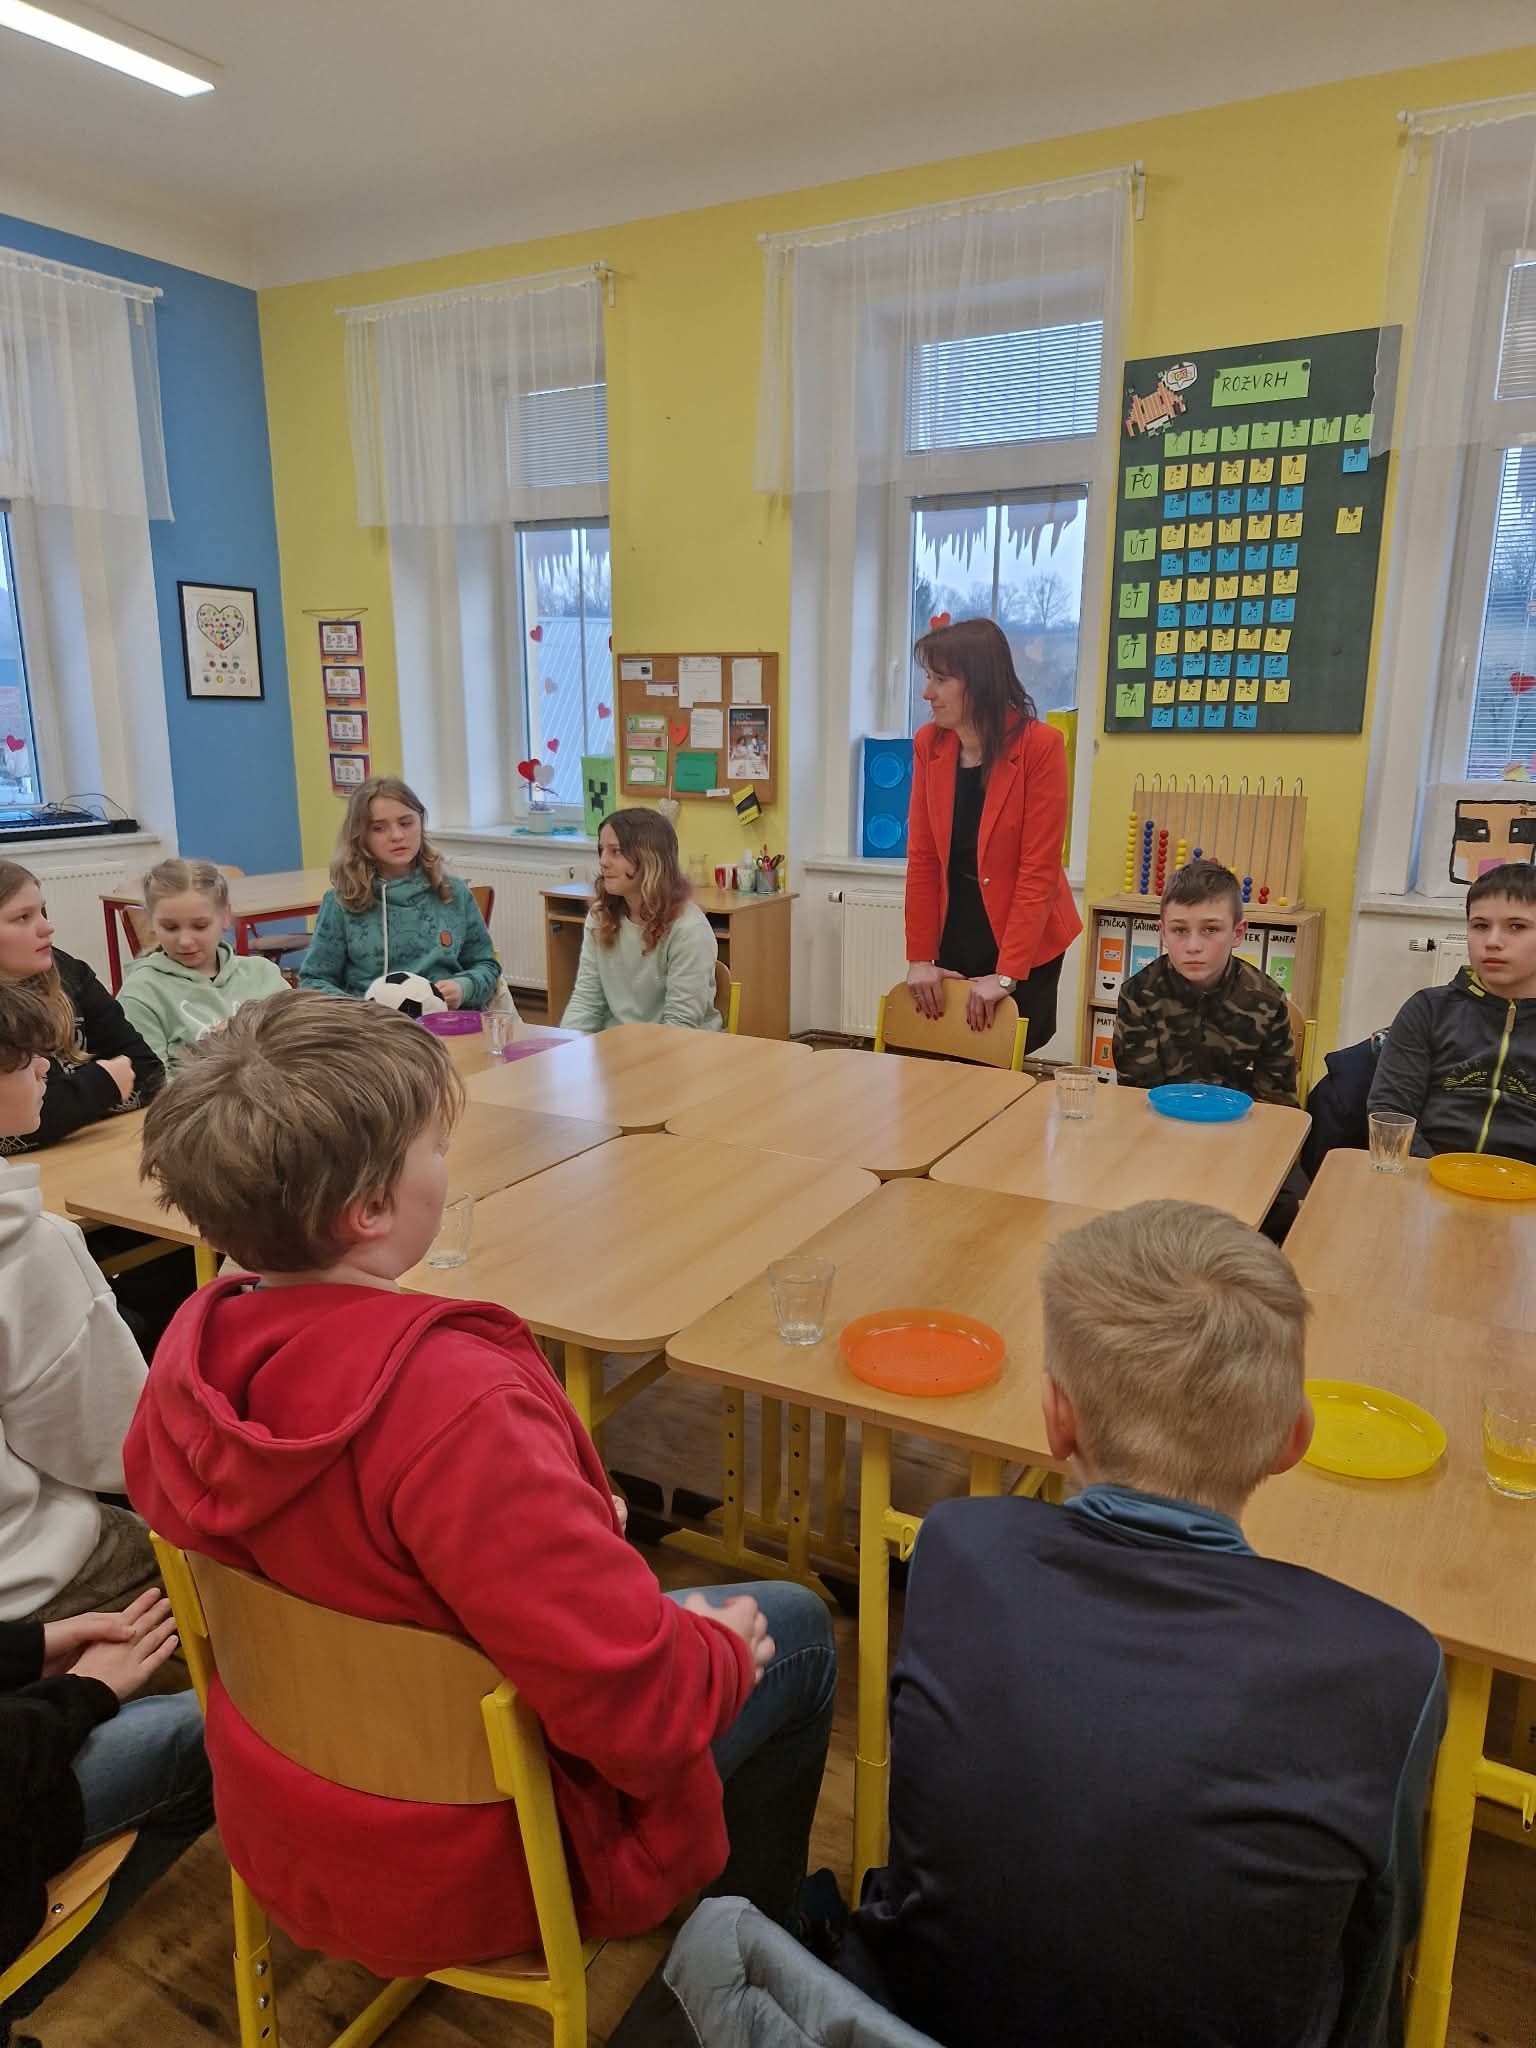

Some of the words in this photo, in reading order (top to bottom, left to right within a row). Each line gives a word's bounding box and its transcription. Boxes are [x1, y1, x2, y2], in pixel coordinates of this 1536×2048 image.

[1221, 371, 1288, 392] ROZVRH
[1289, 425, 1301, 439] 5
[1353, 418, 1361, 433] 6
[1200, 434, 1207, 447] 2
[1229, 434, 1238, 445] 3
[1131, 472, 1153, 493] PO
[1124, 591, 1143, 609] ST
[1122, 638, 1140, 659] ČT
[1121, 691, 1137, 708] PA
[1245, 933, 1260, 942] TEK
[1270, 934, 1296, 944] JANEK
